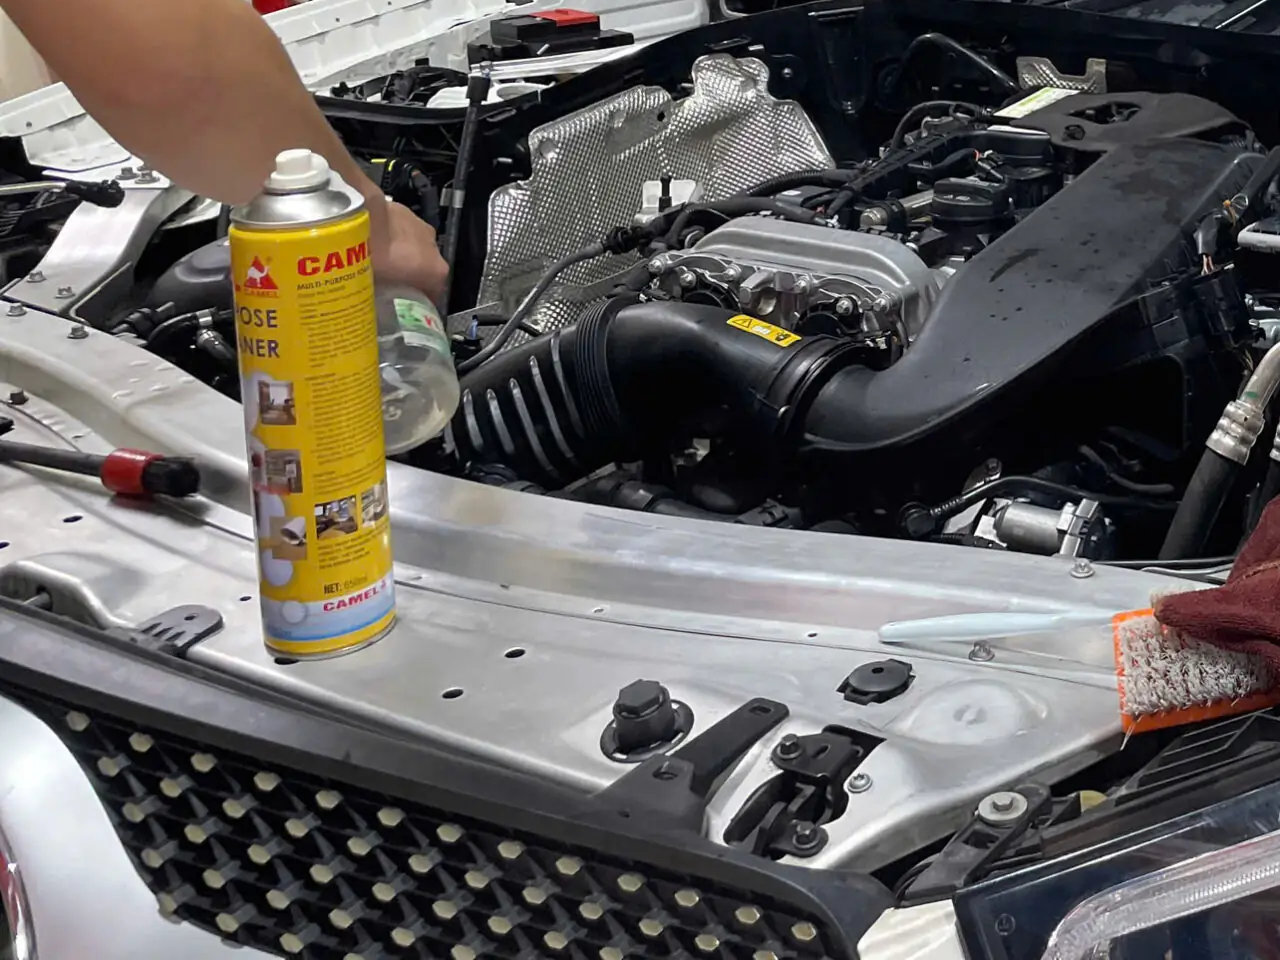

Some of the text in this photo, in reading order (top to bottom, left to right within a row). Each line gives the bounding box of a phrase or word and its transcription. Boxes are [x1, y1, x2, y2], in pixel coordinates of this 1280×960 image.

[236, 306, 278, 328] OSE
[240, 336, 279, 358] NER
[323, 586, 380, 612] CAMEL
